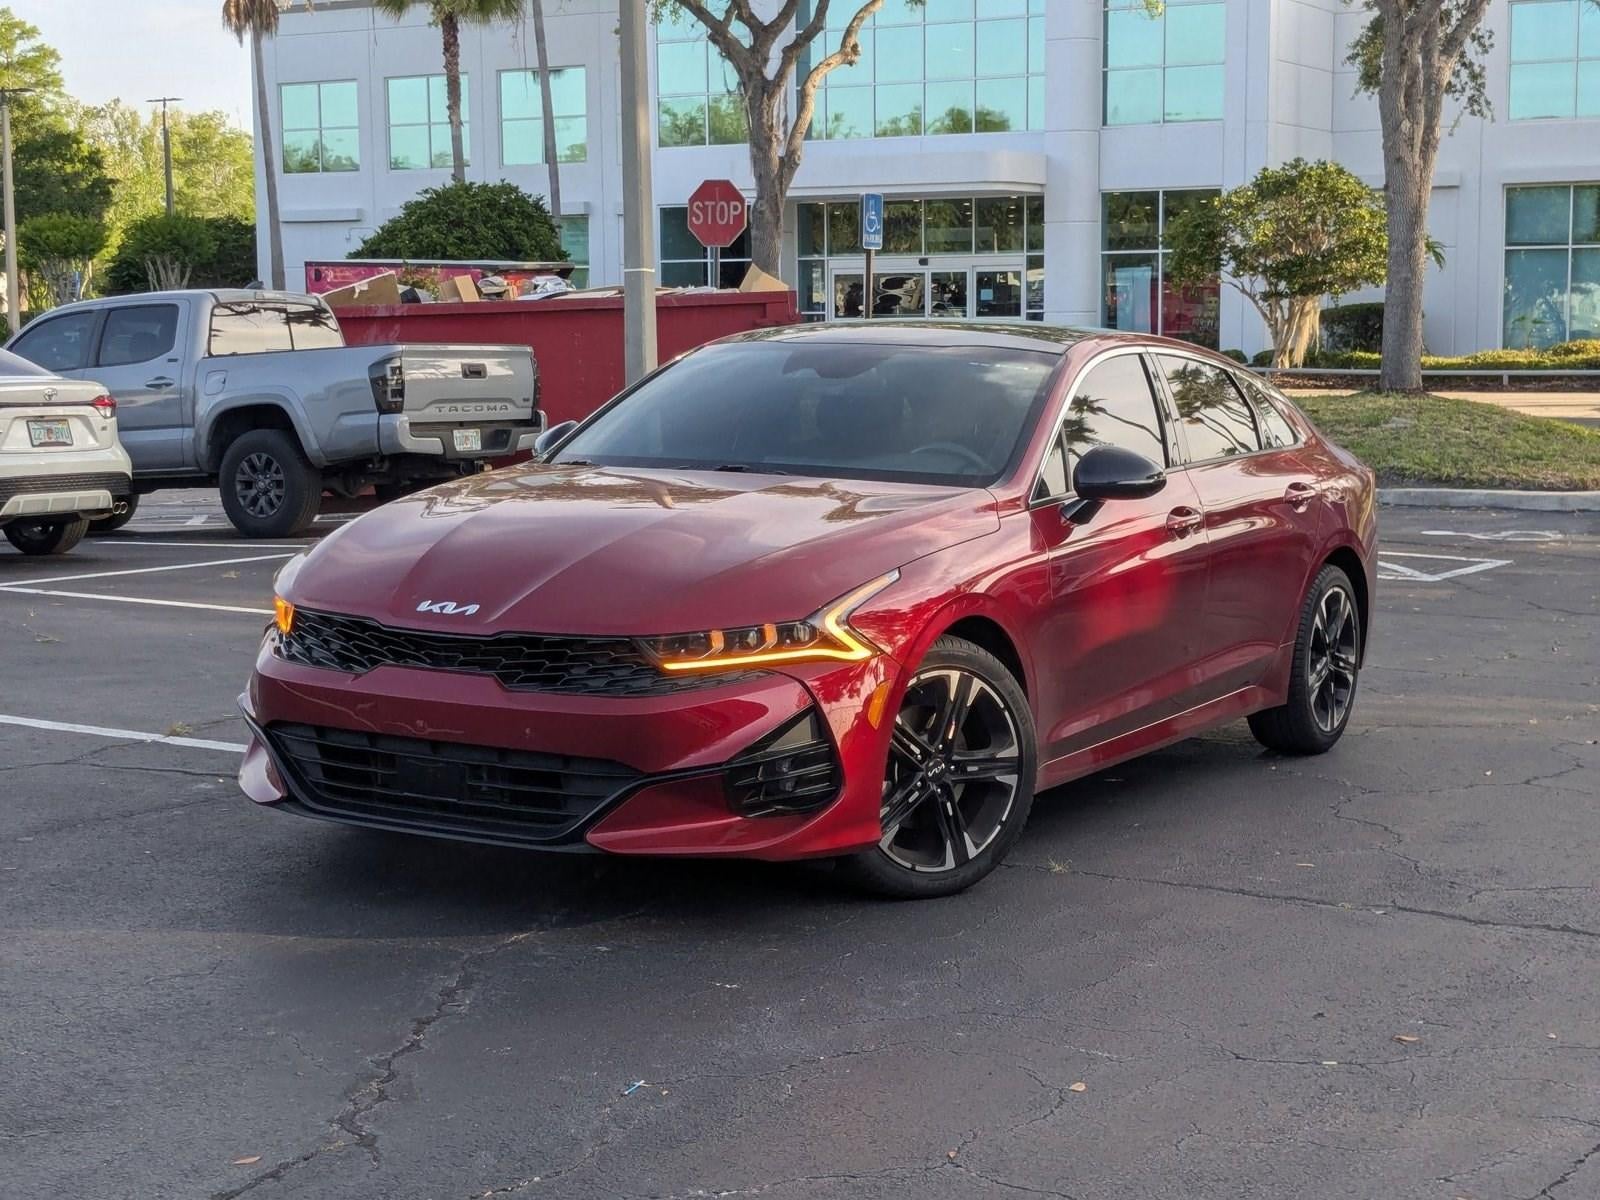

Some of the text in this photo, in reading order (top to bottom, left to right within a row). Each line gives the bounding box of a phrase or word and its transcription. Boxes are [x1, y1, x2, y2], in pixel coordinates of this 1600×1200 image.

[692, 201, 742, 225] STOP
[434, 404, 508, 413] TACOMA
[416, 600, 480, 615] KIA
